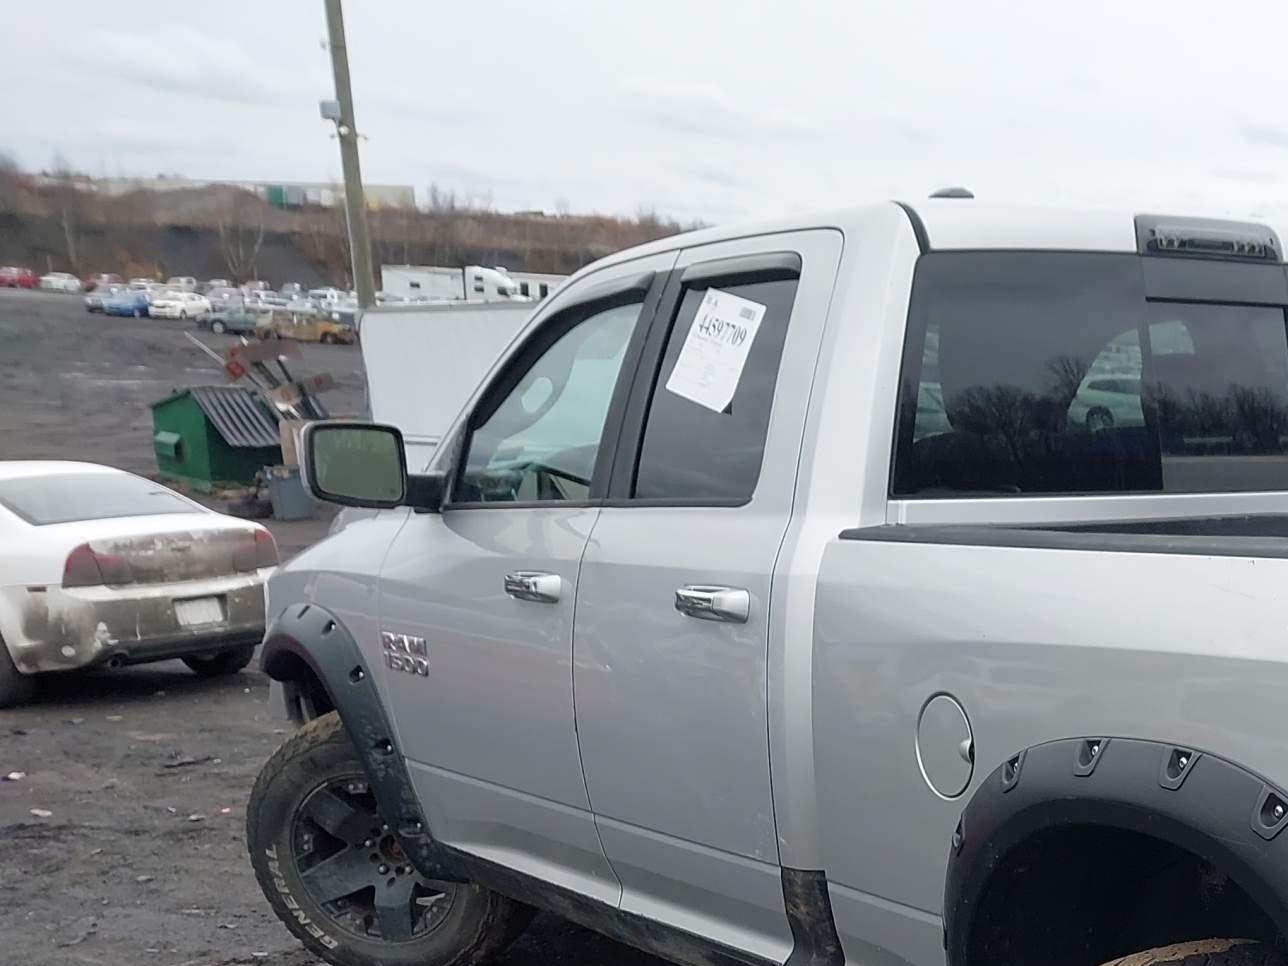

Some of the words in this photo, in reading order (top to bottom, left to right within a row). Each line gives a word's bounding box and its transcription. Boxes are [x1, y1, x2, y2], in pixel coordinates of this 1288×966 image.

[698, 313, 748, 346] 44597709
[382, 631, 427, 657] RAM
[384, 651, 429, 677] 1500
[264, 843, 338, 950] GENERAL
